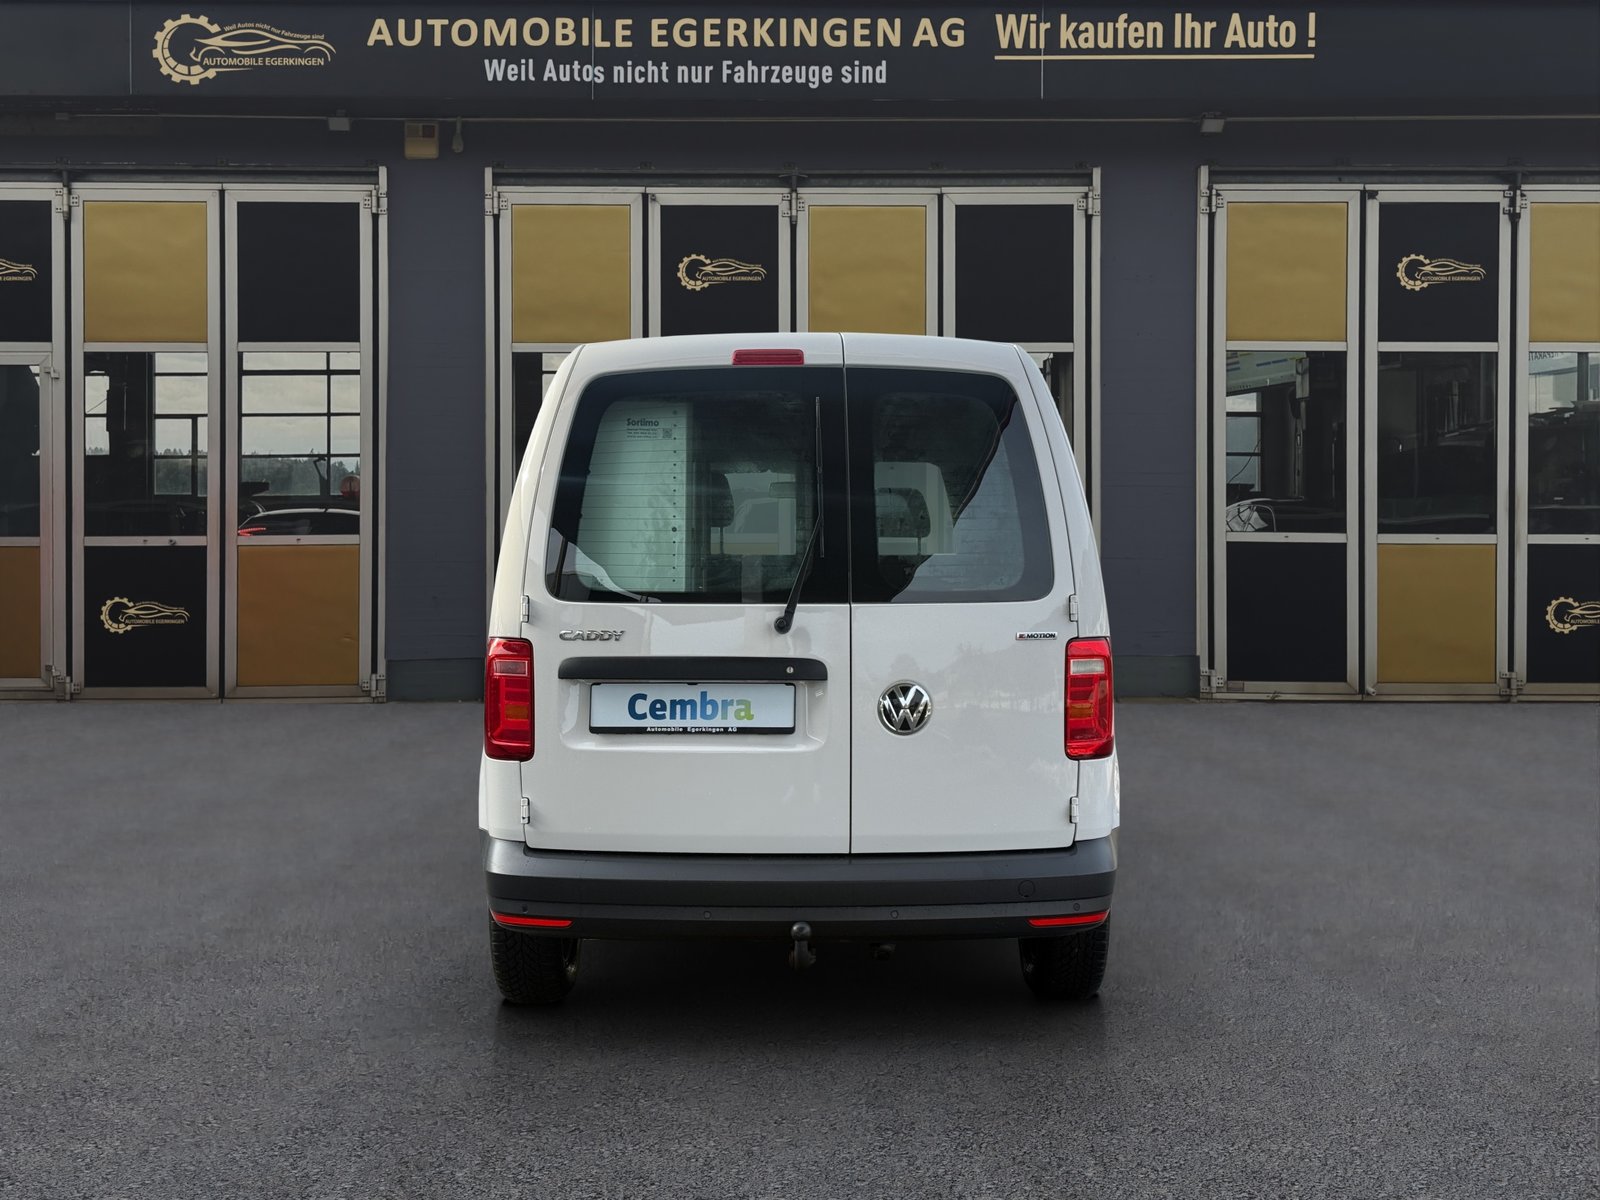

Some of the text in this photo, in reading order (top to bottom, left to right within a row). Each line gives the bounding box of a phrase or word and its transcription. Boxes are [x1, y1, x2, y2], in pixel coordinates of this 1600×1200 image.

[224, 23, 237, 32] Weil
[255, 23, 271, 32] nicht
[271, 26, 281, 35] nur
[281, 29, 311, 40] Fahrzeuge
[366, 17, 966, 48] AUTOMOBILE EGERKINGEN AG
[995, 12, 1316, 49] Wir kaufen Ihr Auto !
[203, 57, 325, 66] AUTOMOBILE EGERKINGEN
[484, 58, 887, 89] Weil Autos nicht nur Fahrzeuge sind
[626, 418, 660, 427] Sortimo
[559, 630, 626, 642] CADDY
[627, 690, 755, 722] Cembra
